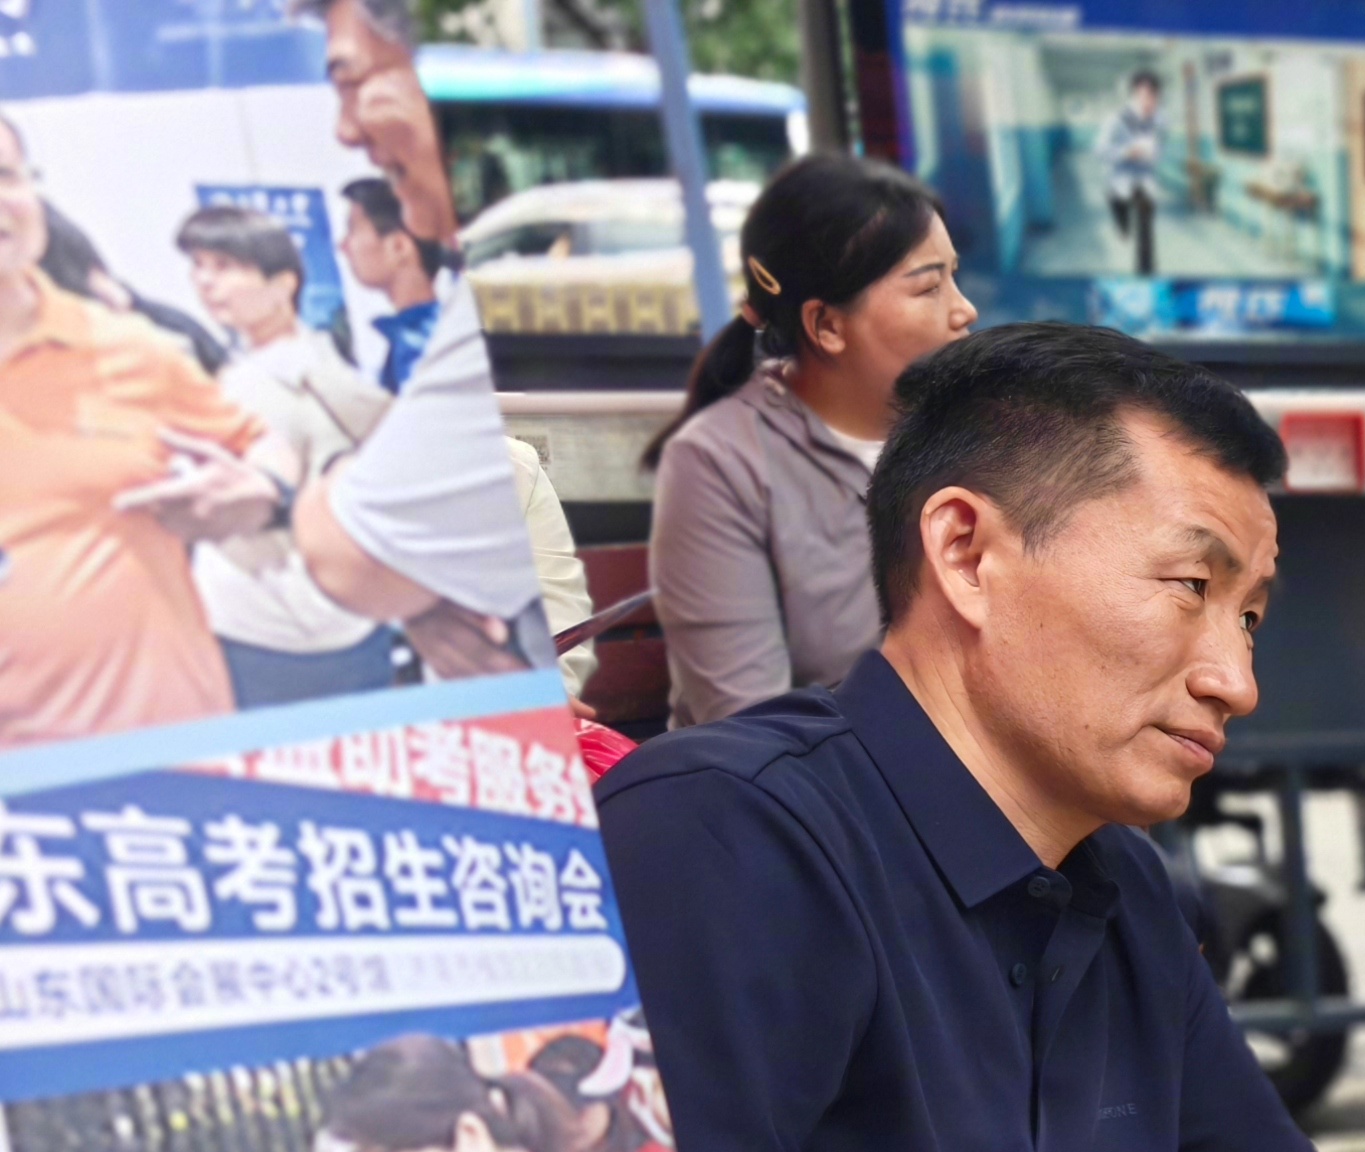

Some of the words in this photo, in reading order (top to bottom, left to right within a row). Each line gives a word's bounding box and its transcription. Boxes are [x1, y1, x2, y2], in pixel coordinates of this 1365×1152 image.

[0, 803, 608, 936] 东高考招生咨询会
